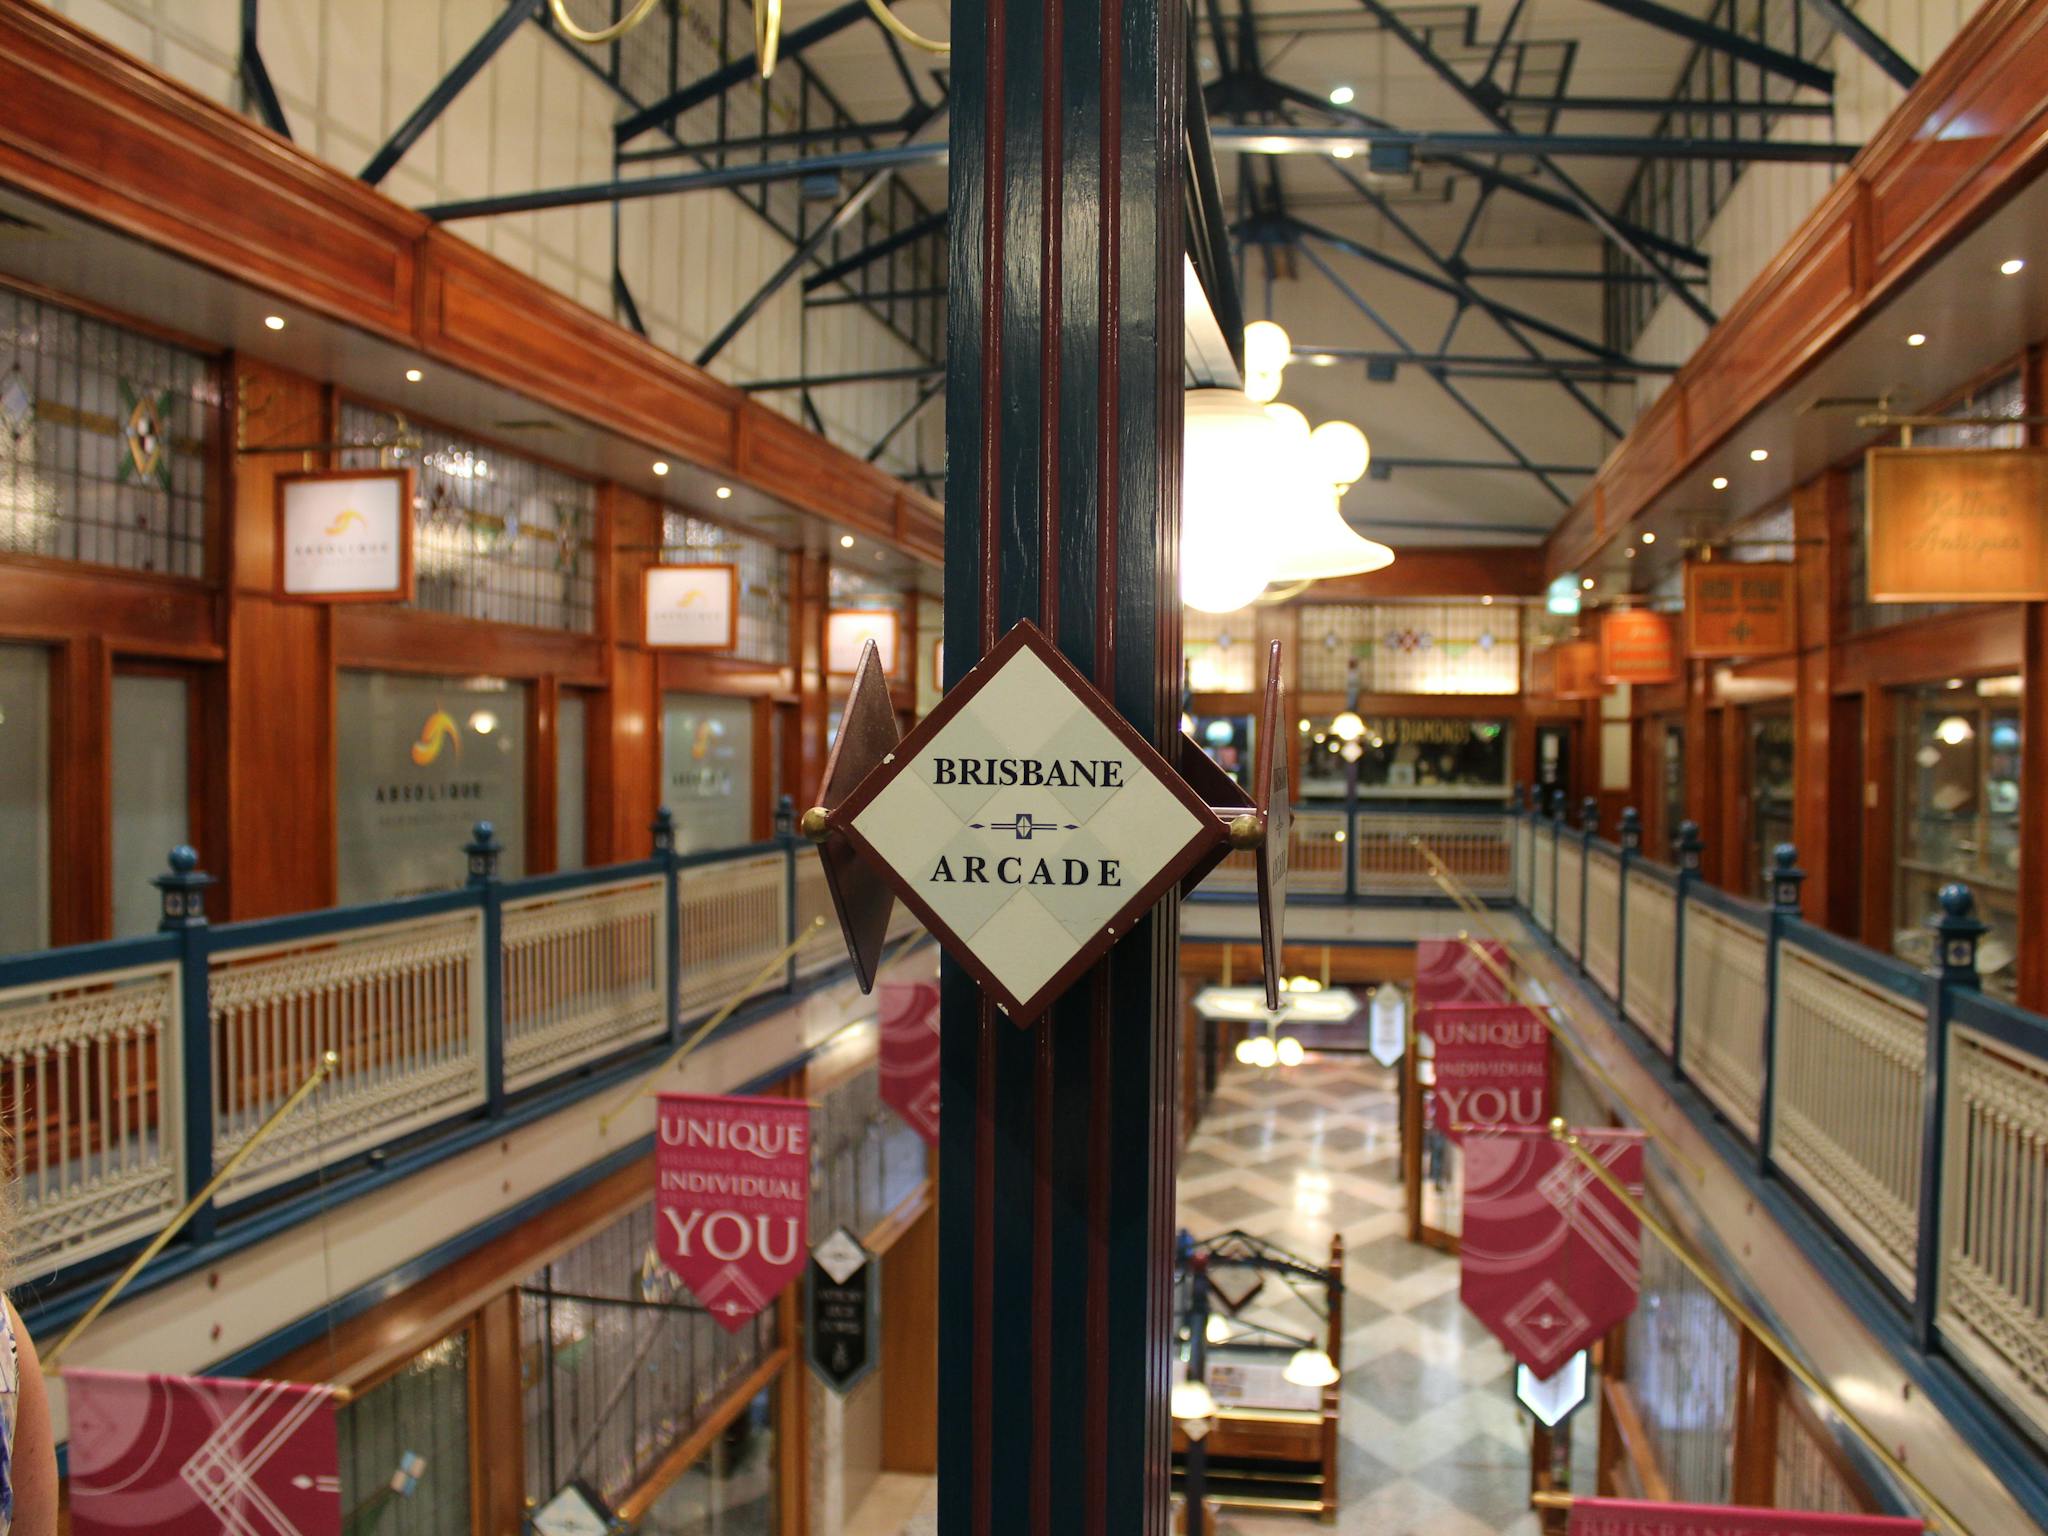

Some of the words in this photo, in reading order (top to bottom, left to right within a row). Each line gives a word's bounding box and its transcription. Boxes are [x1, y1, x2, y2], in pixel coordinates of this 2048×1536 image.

[933, 758, 1124, 788] BRISBANE
[376, 782, 482, 801] ABSOLIQUE
[929, 855, 1122, 887] ARCADE
[1434, 1022, 1546, 1048] UNIQUE
[1438, 1061, 1544, 1077] INDIVIDUAL
[1438, 1086, 1543, 1125] YOU
[660, 1116, 804, 1159] UNIQUE
[660, 1170, 803, 1200] INDIVIDUAL
[662, 1206, 799, 1265] YOU
